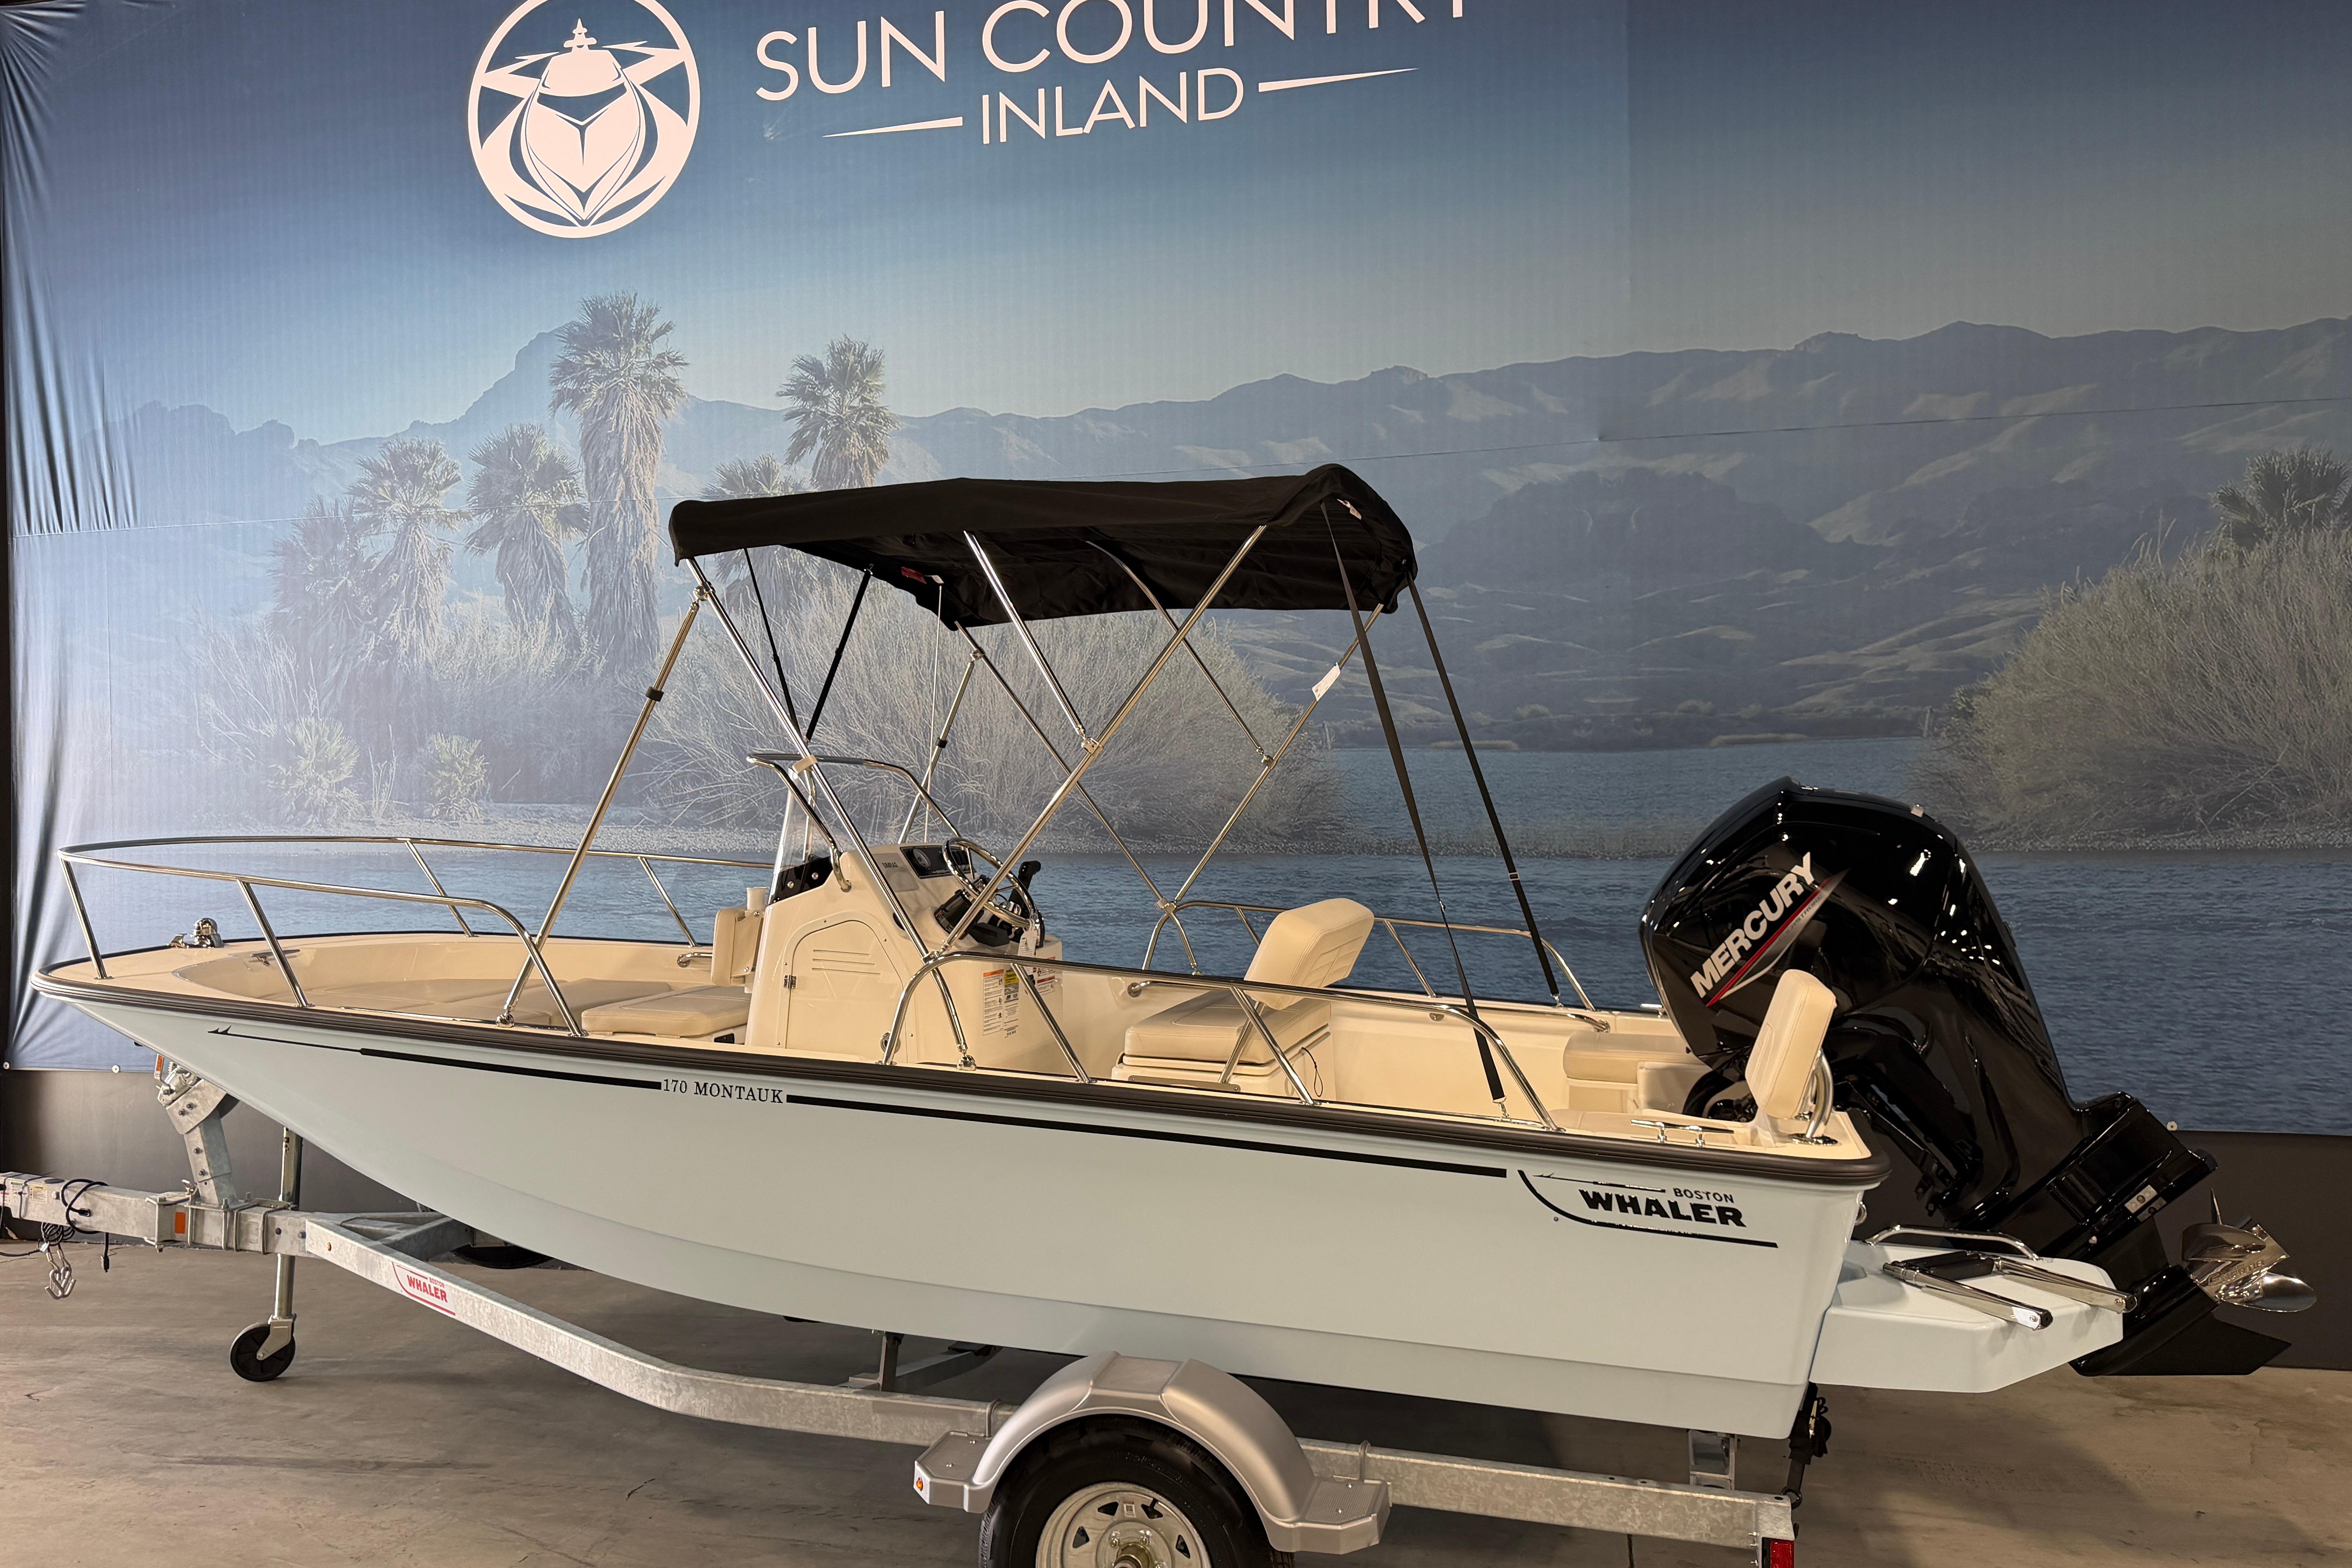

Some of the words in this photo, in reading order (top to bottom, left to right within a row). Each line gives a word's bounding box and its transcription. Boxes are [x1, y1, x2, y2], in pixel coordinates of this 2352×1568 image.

[756, 10, 945, 100] SUN
[982, 0, 1463, 72] COUN
[982, 68, 1244, 144] INLAND
[1690, 852, 1814, 999] MERCURY
[663, 1079, 687, 1093] 170
[694, 1081, 783, 1104] MONTAUK
[1578, 1189, 1747, 1227] WHALER
[1673, 1188, 1734, 1203] BOSTON
[407, 1275, 448, 1303] WHALER
[429, 1277, 445, 1288] BOSTON
